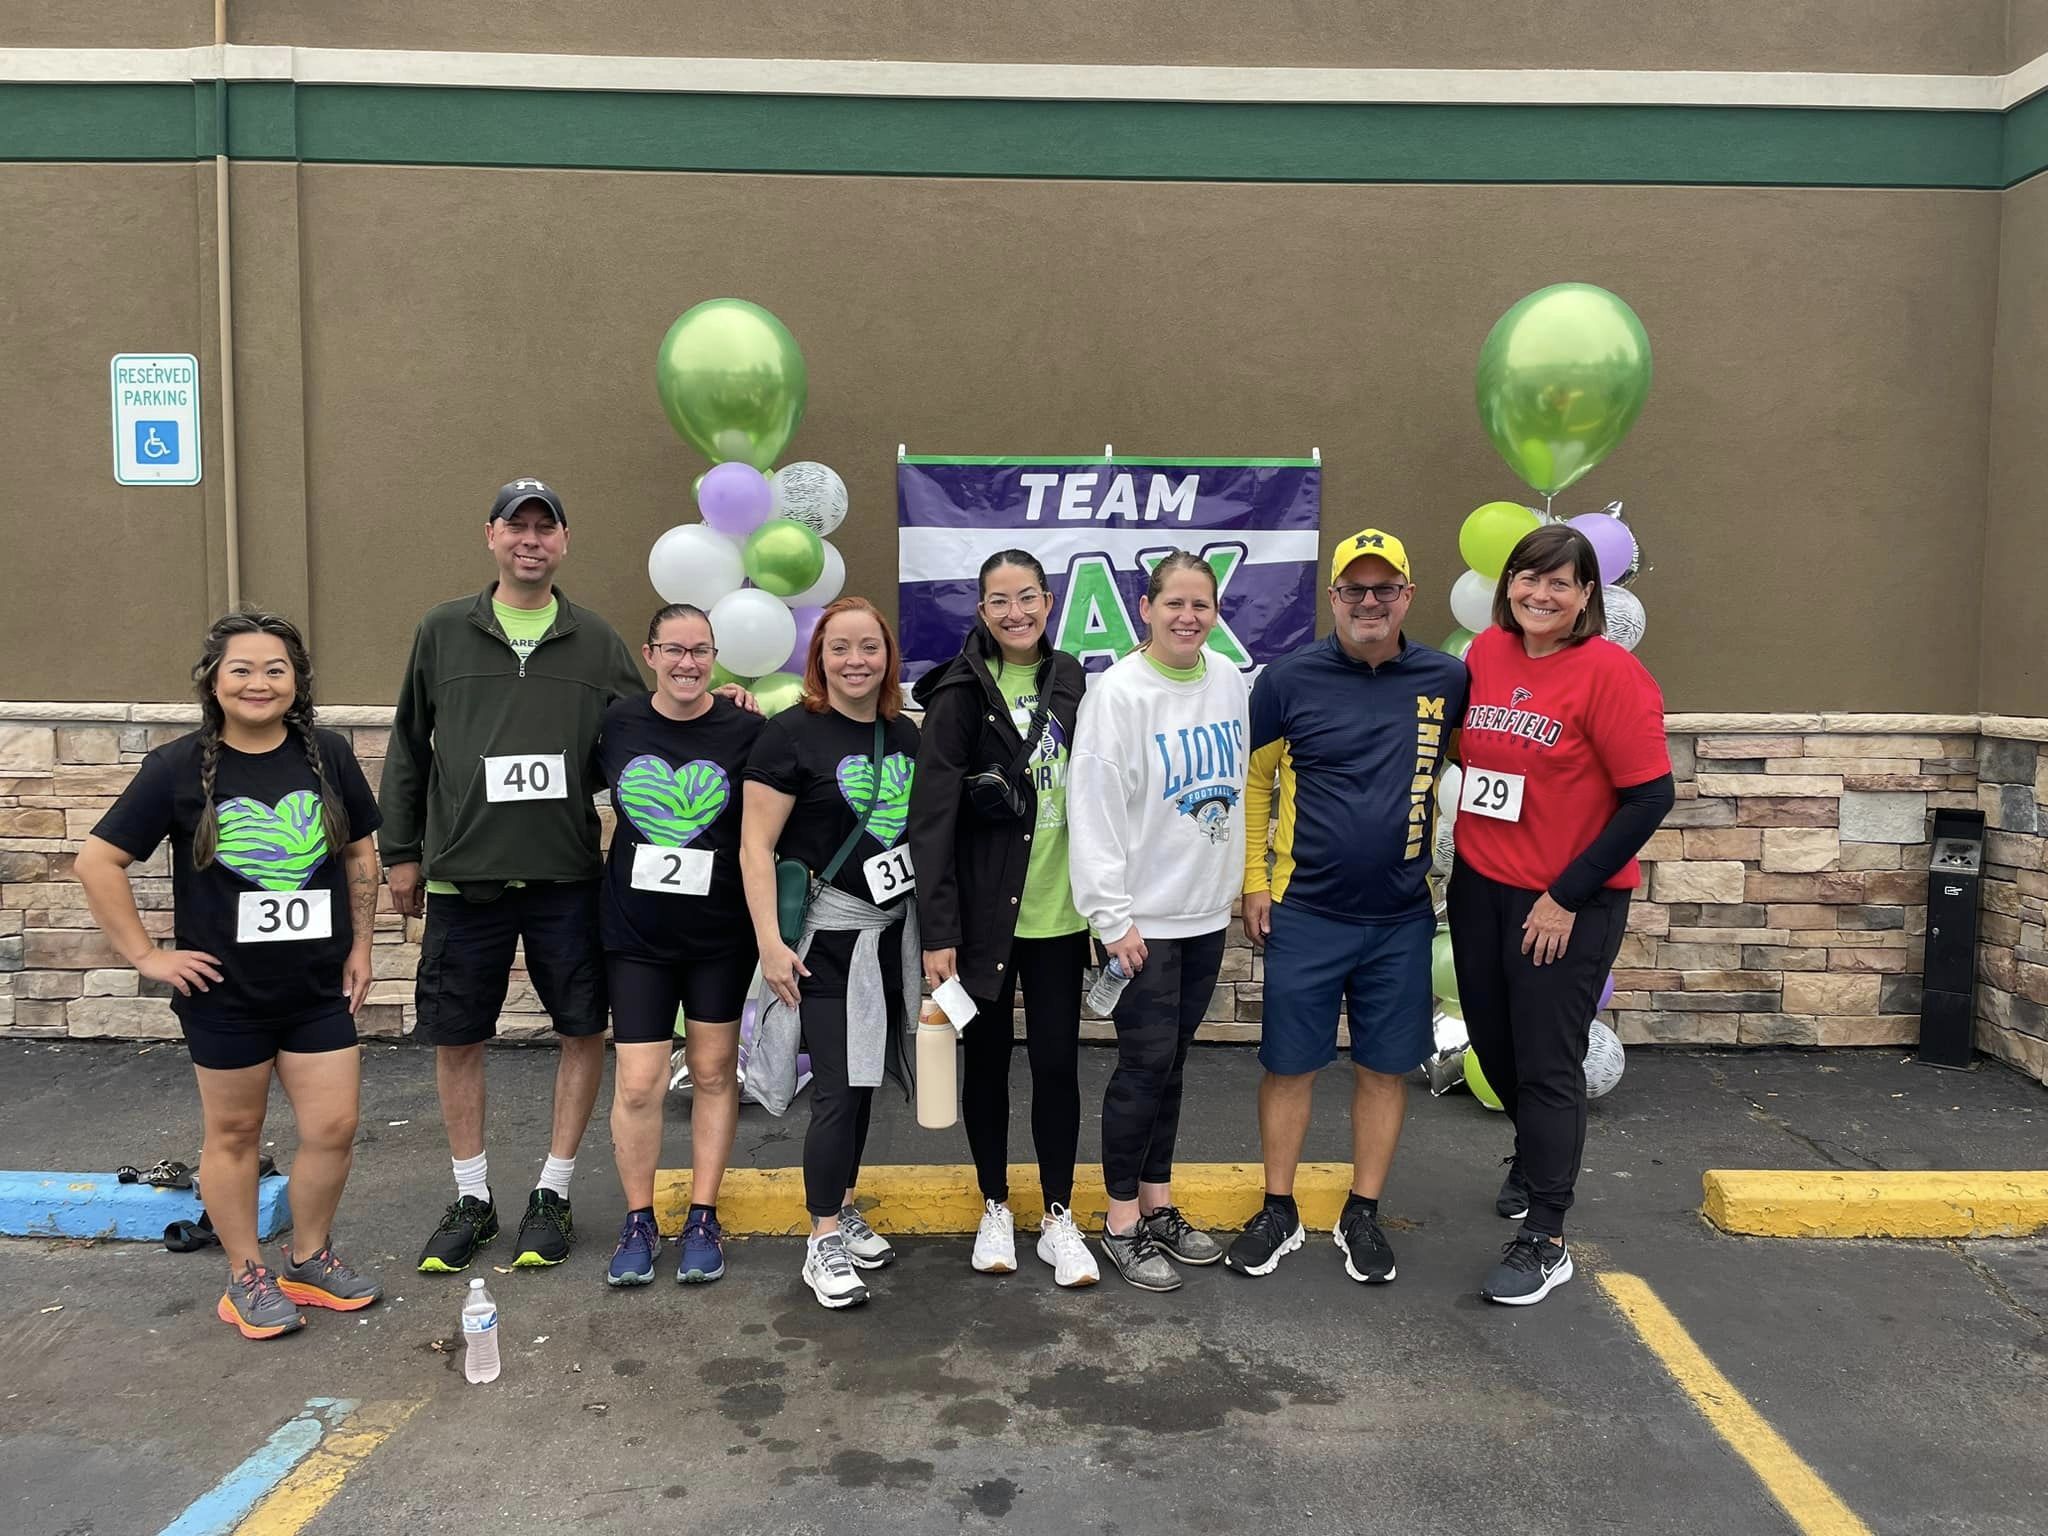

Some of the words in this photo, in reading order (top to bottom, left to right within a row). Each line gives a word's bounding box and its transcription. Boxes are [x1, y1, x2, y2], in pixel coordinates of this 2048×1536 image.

[119, 368, 191, 384] RESERVED
[124, 390, 187, 406] PARKING
[1020, 473, 1200, 521] TEAM
[1355, 534, 1385, 550] M
[1466, 704, 1563, 746] DEERFIELD
[503, 761, 550, 793] 40
[1403, 723, 1442, 860] MICHIGAN
[1473, 776, 1509, 810] 29
[1188, 786, 1230, 803] FOOTBALL
[660, 854, 682, 886] 2
[877, 853, 915, 891] 31
[257, 898, 310, 933] 30
